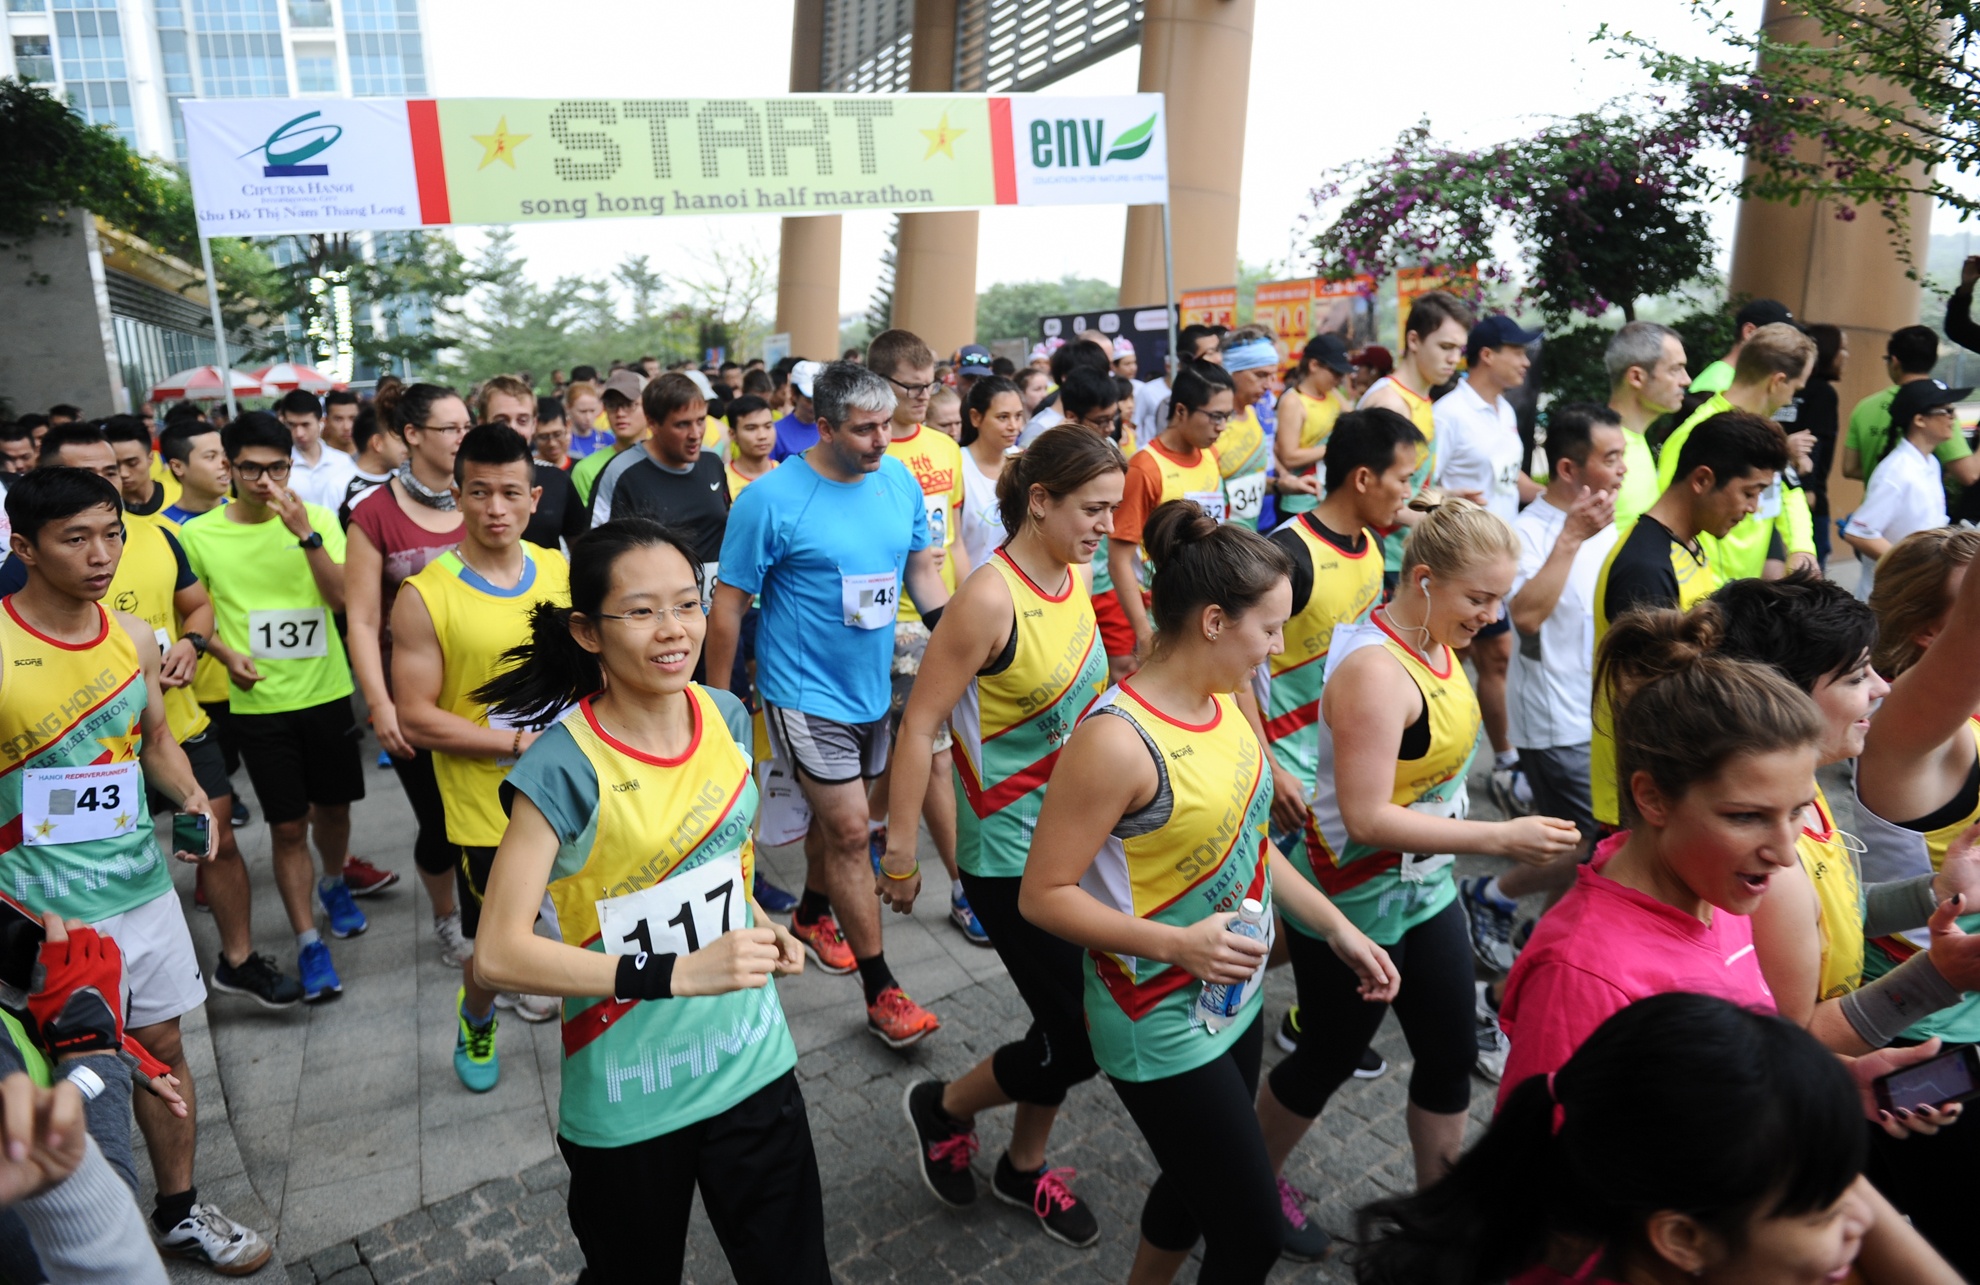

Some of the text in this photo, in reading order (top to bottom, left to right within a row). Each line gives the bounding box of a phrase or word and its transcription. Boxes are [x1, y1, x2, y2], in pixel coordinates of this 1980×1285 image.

[549, 99, 893, 182] START
[1030, 119, 1104, 168] env
[242, 182, 354, 197] CIPUTRA HANOI
[370, 202, 406, 217] Long
[521, 184, 934, 217] song hong hanoi half marathon
[258, 619, 319, 648] 137
[14, 658, 43, 667] SCORE
[1016, 612, 1093, 716] SONG HONG
[3, 667, 118, 761] SONG HONG
[58, 696, 130, 758] MARATHON
[38, 767, 128, 782] HANOI REDRIVERRUNNERS
[77, 784, 121, 812] 43
[1175, 736, 1258, 883] SONG HONG
[606, 779, 725, 901] ONG HONG
[675, 810, 748, 882] RATHON
[1203, 856, 1239, 905] HALF
[1213, 880, 1245, 914] 2015
[622, 878, 734, 955] 117
